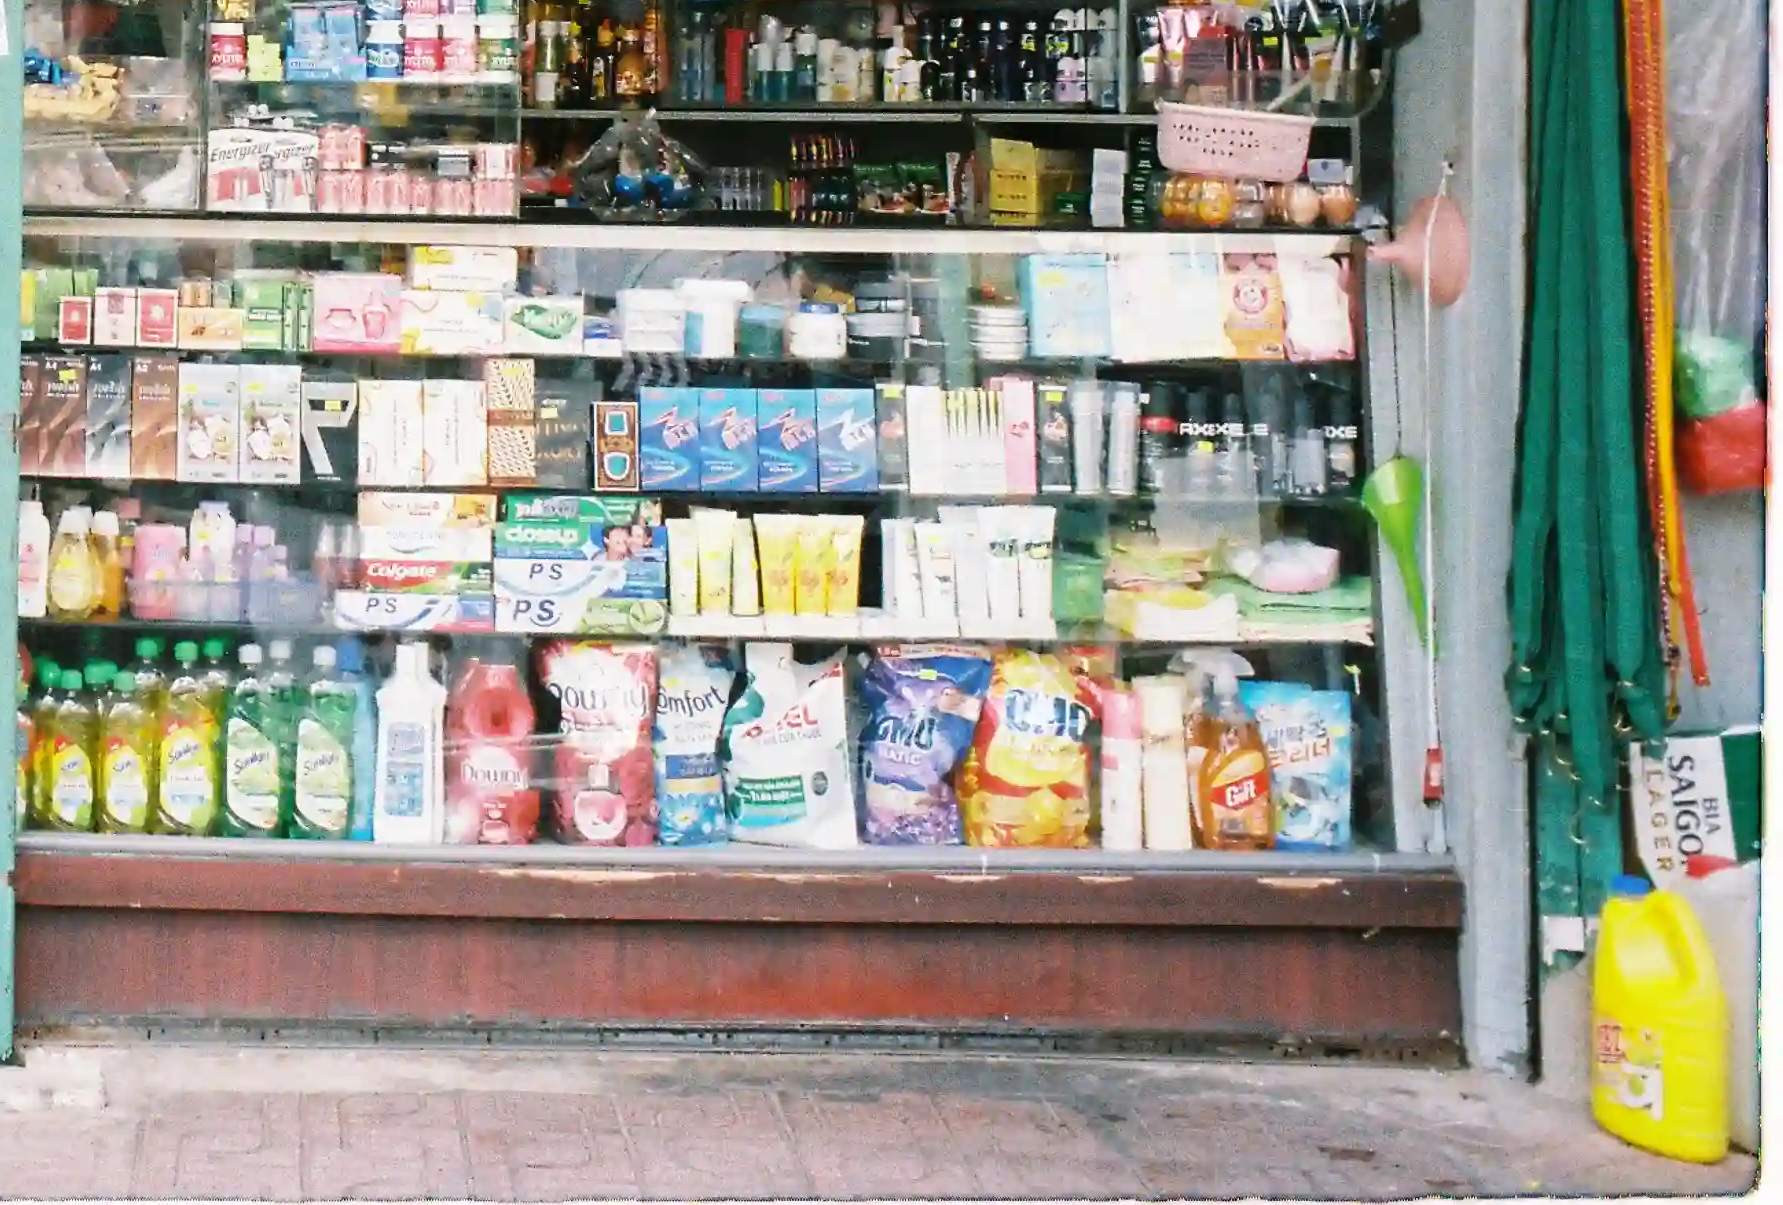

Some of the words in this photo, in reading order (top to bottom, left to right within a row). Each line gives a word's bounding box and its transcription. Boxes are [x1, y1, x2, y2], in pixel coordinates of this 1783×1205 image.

[367, 563, 438, 581] Colgate
[1646, 768, 1673, 873] LAGER
[1668, 754, 1704, 866] SAIGO
[1702, 797, 1722, 835] BIA
